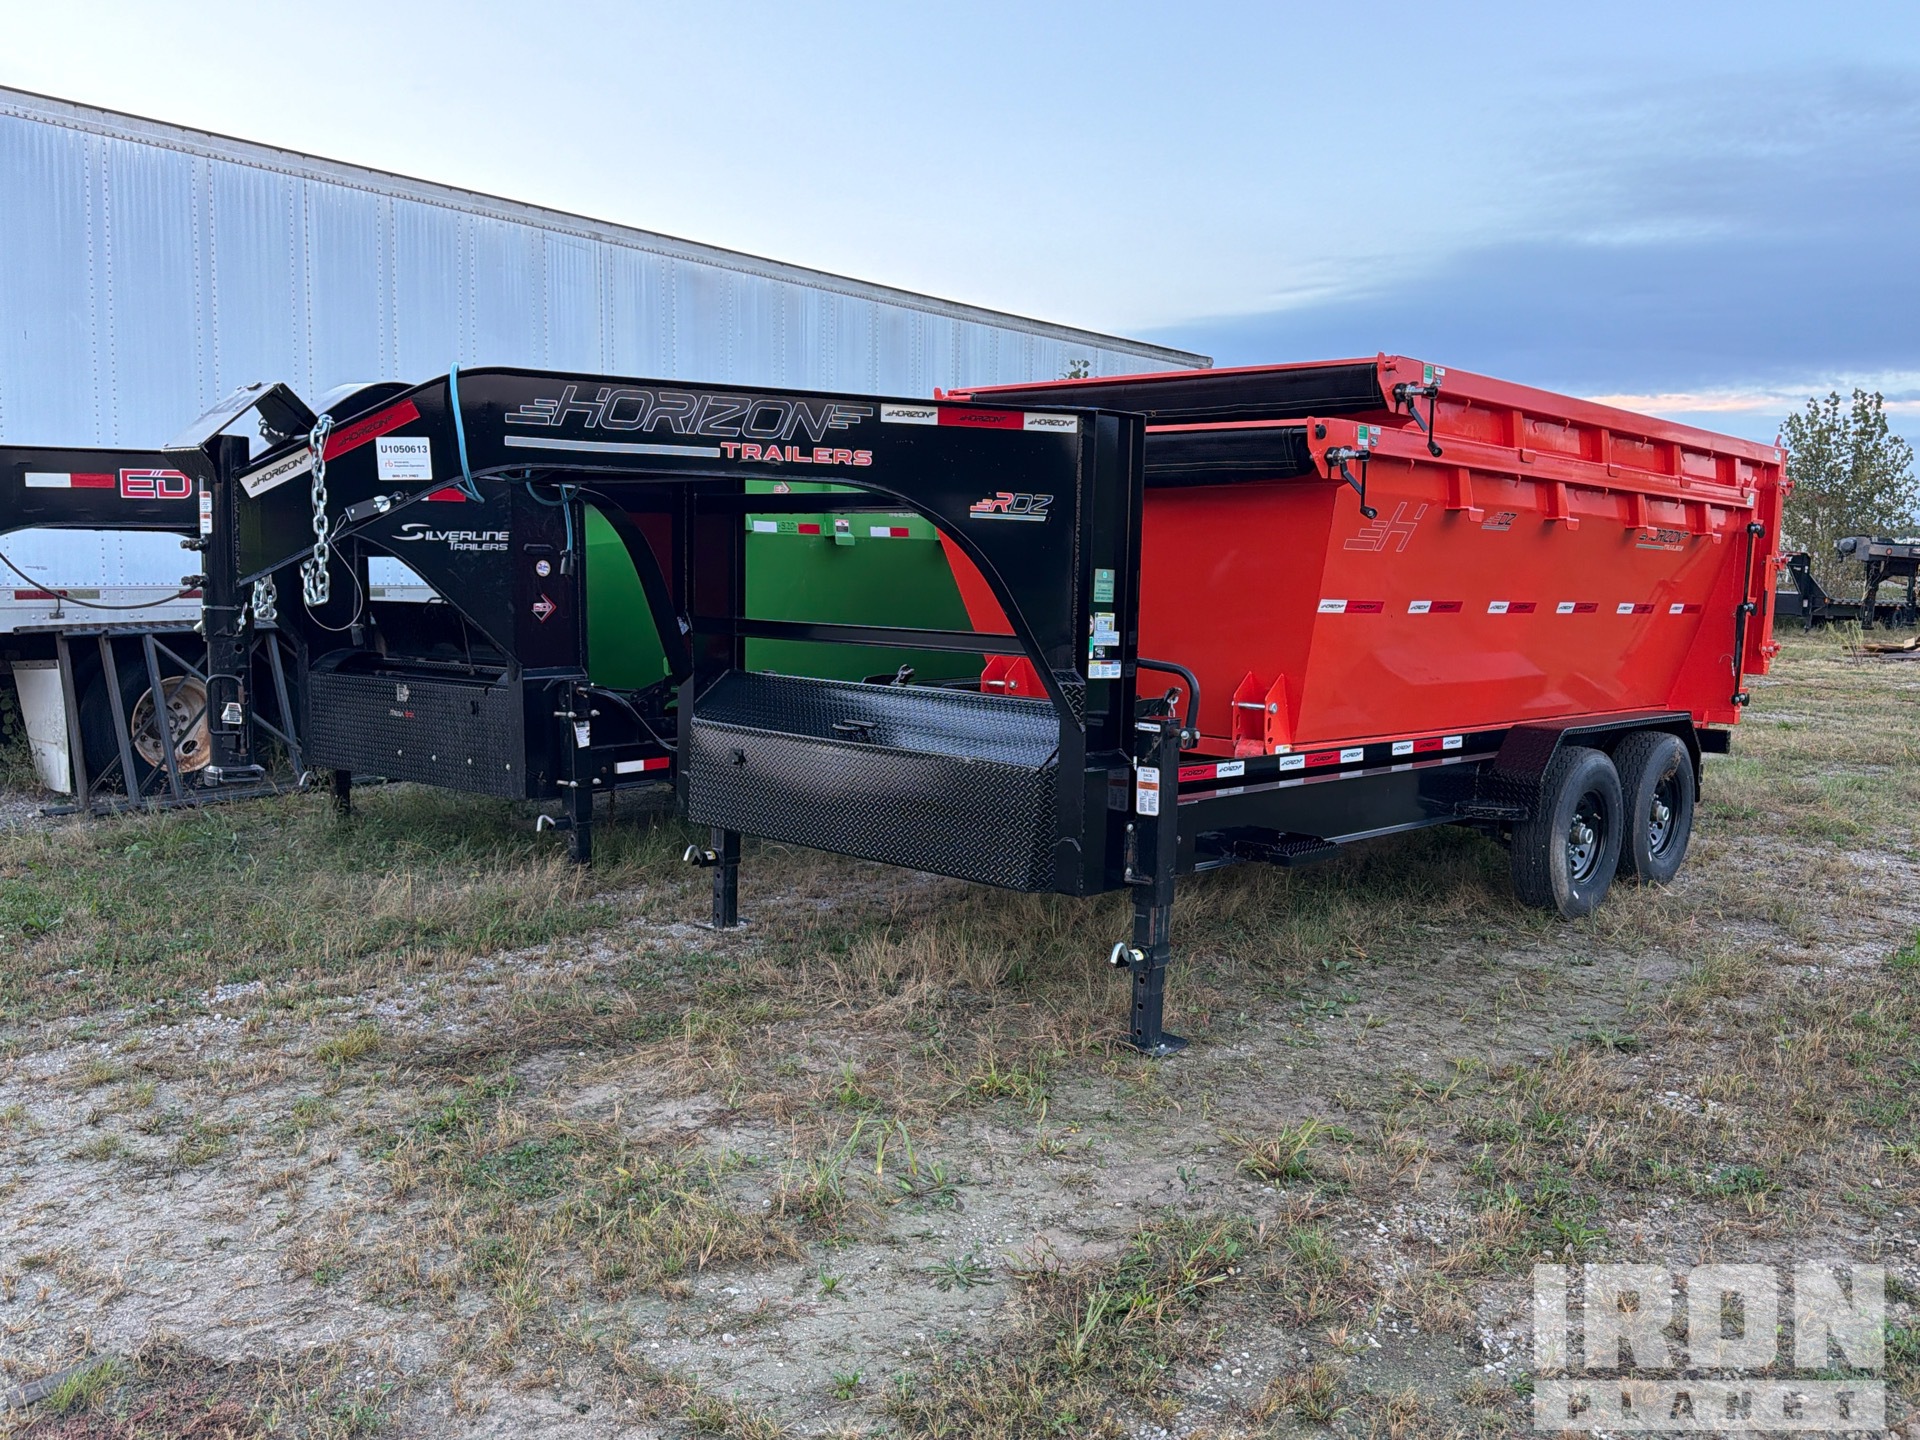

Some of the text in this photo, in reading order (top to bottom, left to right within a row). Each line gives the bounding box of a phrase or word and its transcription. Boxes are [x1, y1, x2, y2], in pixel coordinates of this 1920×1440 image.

[549, 385, 837, 443] HORIZON
[889, 409, 931, 418] HORIZON
[1032, 418, 1071, 426] HORIZON
[380, 445, 428, 454] U1050613
[720, 441, 873, 466] TRAILERS
[255, 455, 304, 486] HORIZON
[391, 523, 510, 541] SILVERLINE
[447, 540, 509, 551] TRAILERS
